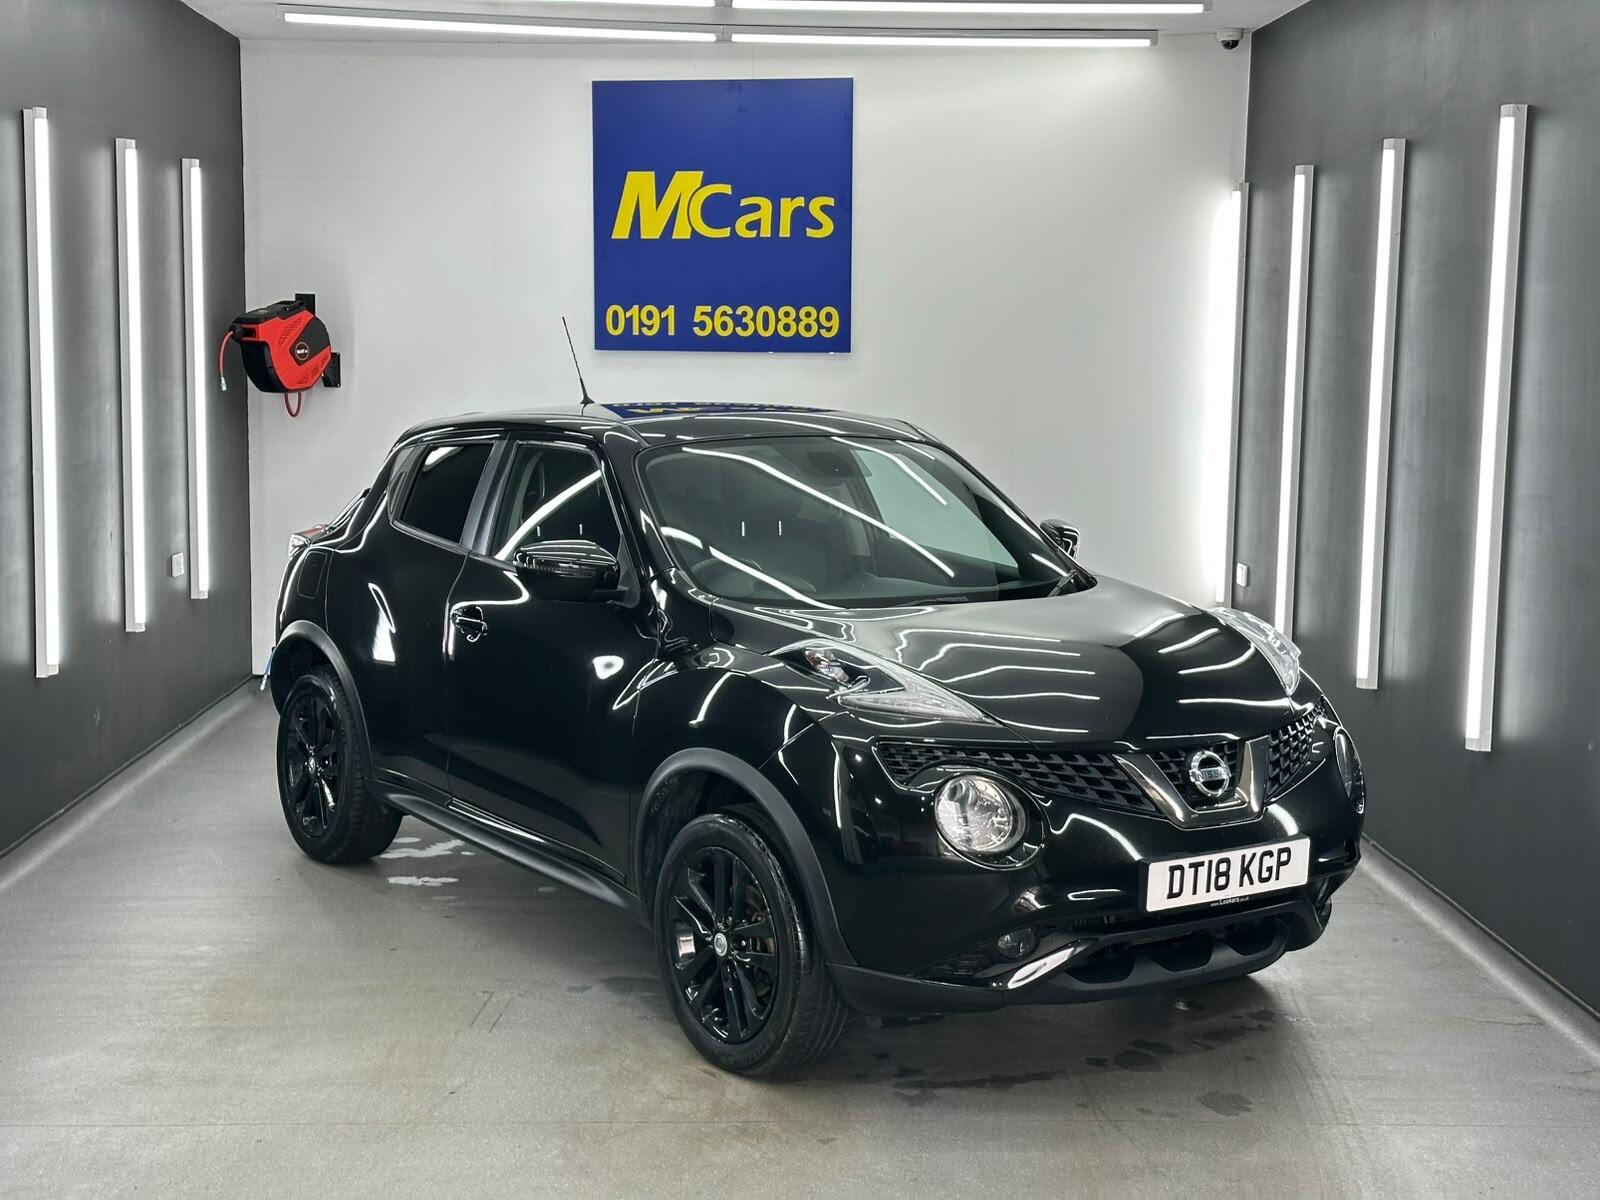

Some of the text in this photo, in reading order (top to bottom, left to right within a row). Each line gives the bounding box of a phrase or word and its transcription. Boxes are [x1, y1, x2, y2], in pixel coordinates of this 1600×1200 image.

[611, 170, 836, 240] MCars
[605, 304, 840, 338] 0191 5630889
[1166, 847, 1292, 900] DT18 KGP
